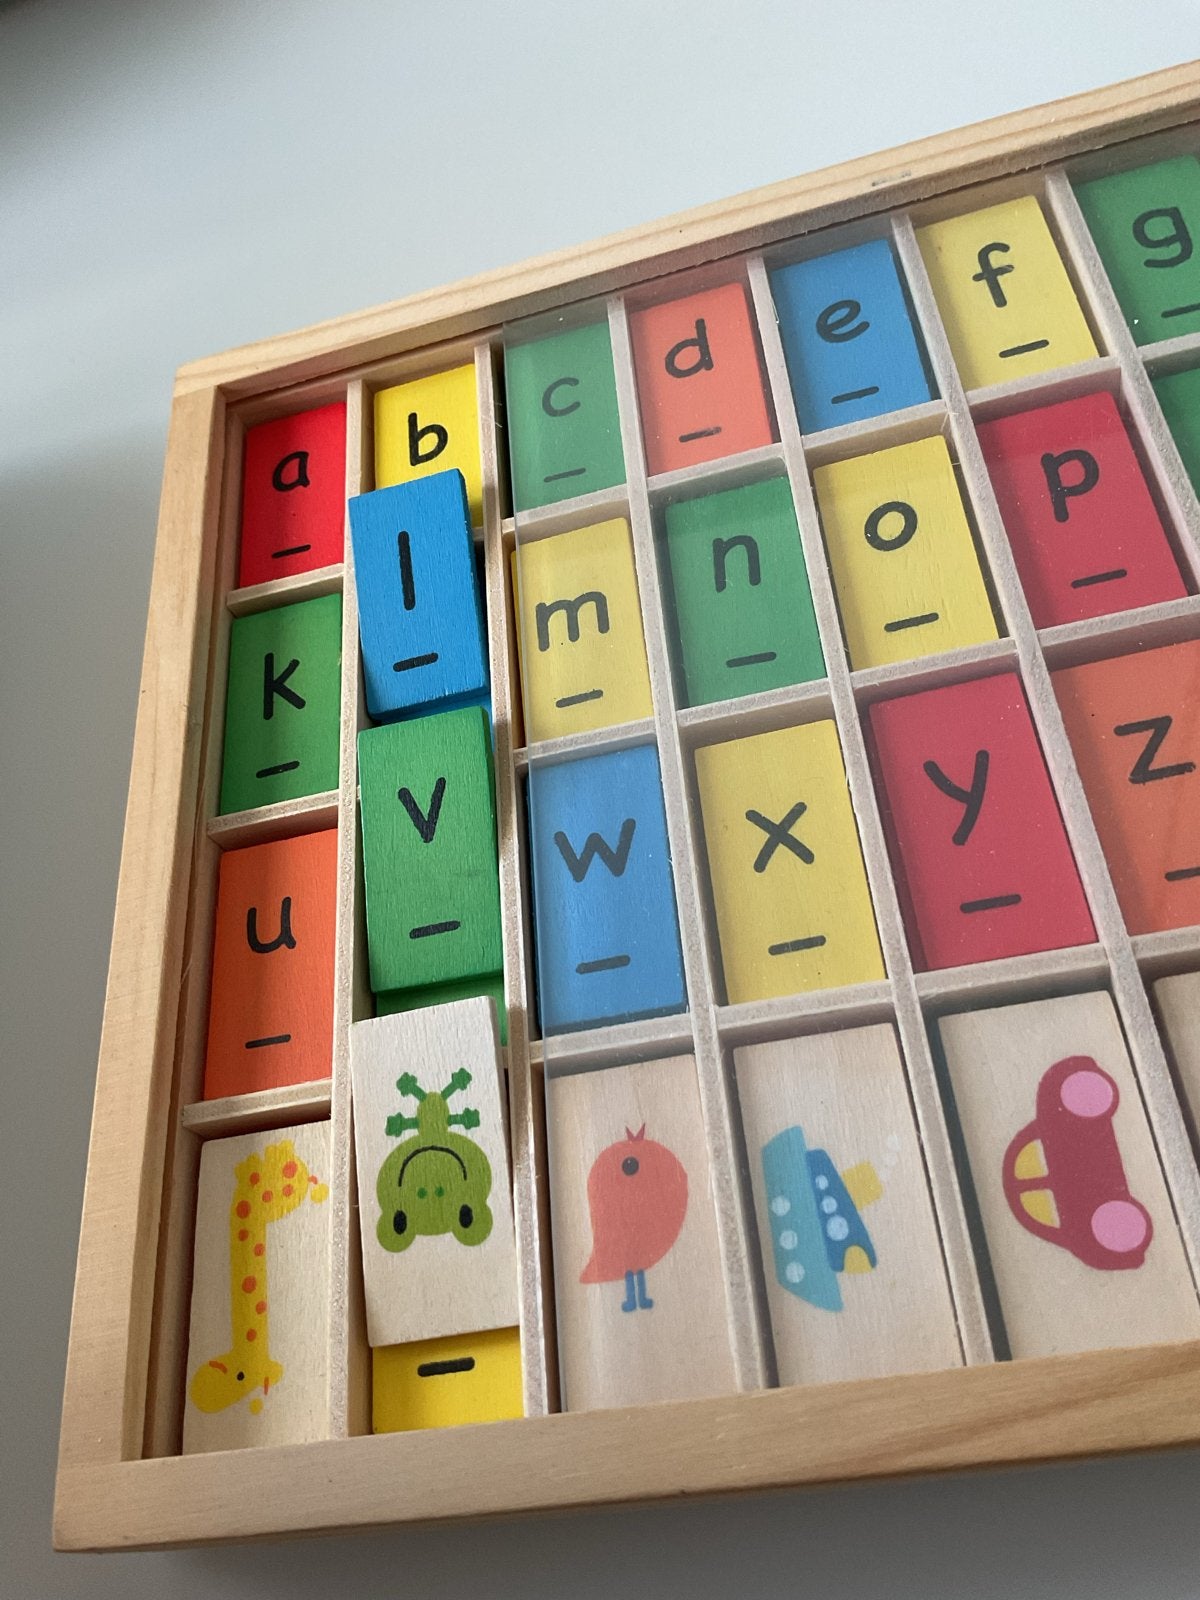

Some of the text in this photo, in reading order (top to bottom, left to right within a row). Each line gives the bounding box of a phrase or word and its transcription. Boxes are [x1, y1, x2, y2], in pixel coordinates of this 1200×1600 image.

[1133, 207, 1193, 268] g
[973, 242, 1014, 307] f
[665, 318, 714, 378] d
[816, 300, 870, 343] e
[542, 377, 580, 417] c
[408, 413, 448, 466] b
[272, 451, 309, 492] a
[1041, 450, 1099, 522] p
[864, 501, 918, 551] o
[712, 535, 761, 592] n
[536, 592, 609, 652] m
[263, 652, 305, 720] k
[1114, 716, 1196, 785] z
[398, 777, 446, 843] v
[923, 750, 989, 846] y
[554, 819, 636, 882] w
[745, 802, 814, 873] x
[246, 897, 296, 954] u
